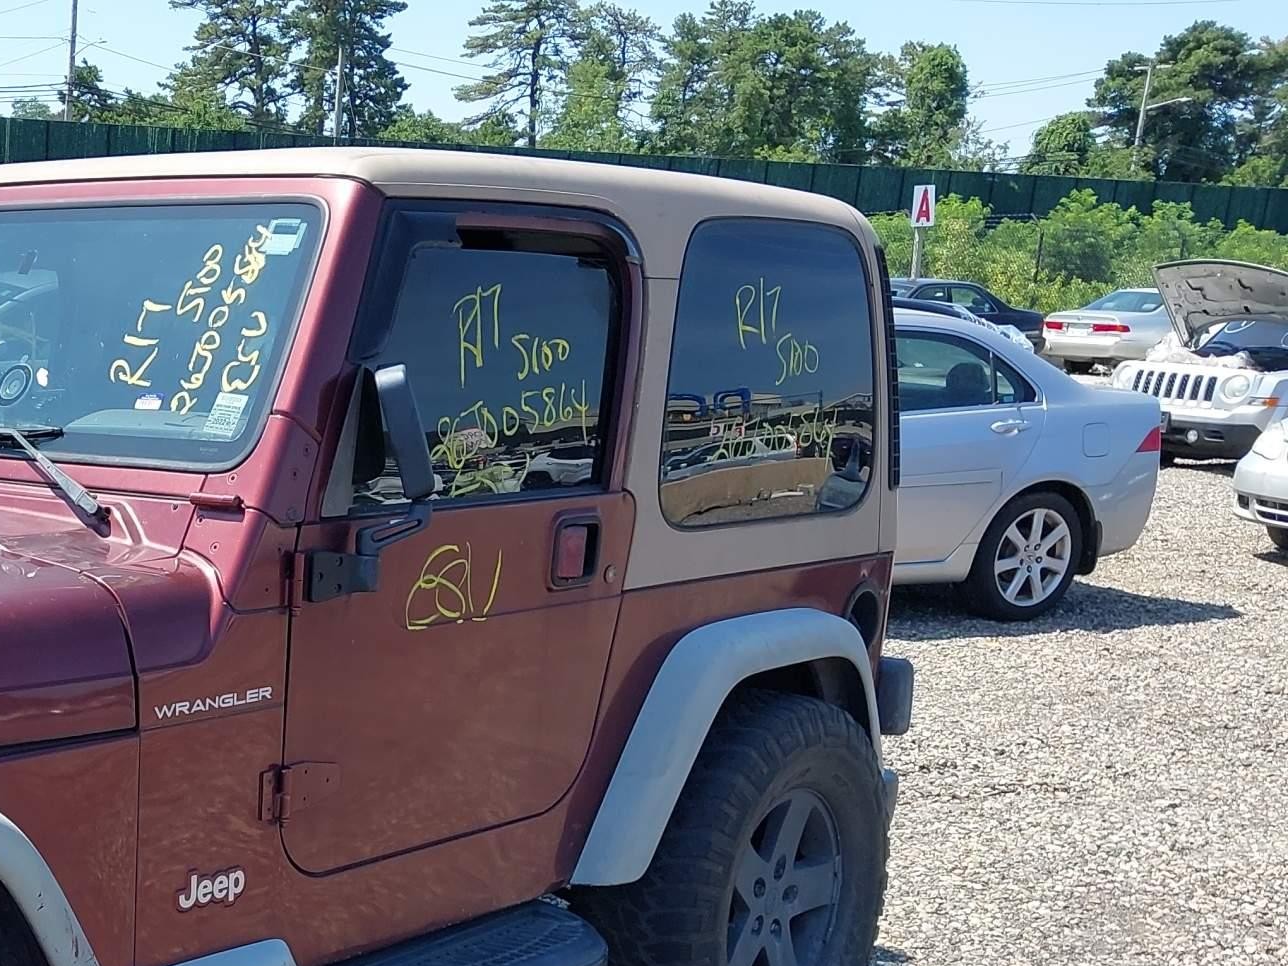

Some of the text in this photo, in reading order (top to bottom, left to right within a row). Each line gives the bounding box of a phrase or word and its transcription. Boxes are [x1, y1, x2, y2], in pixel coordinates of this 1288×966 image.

[915, 186, 931, 224] A
[154, 686, 274, 719] WRANGLER
[177, 868, 246, 910] Jeep
